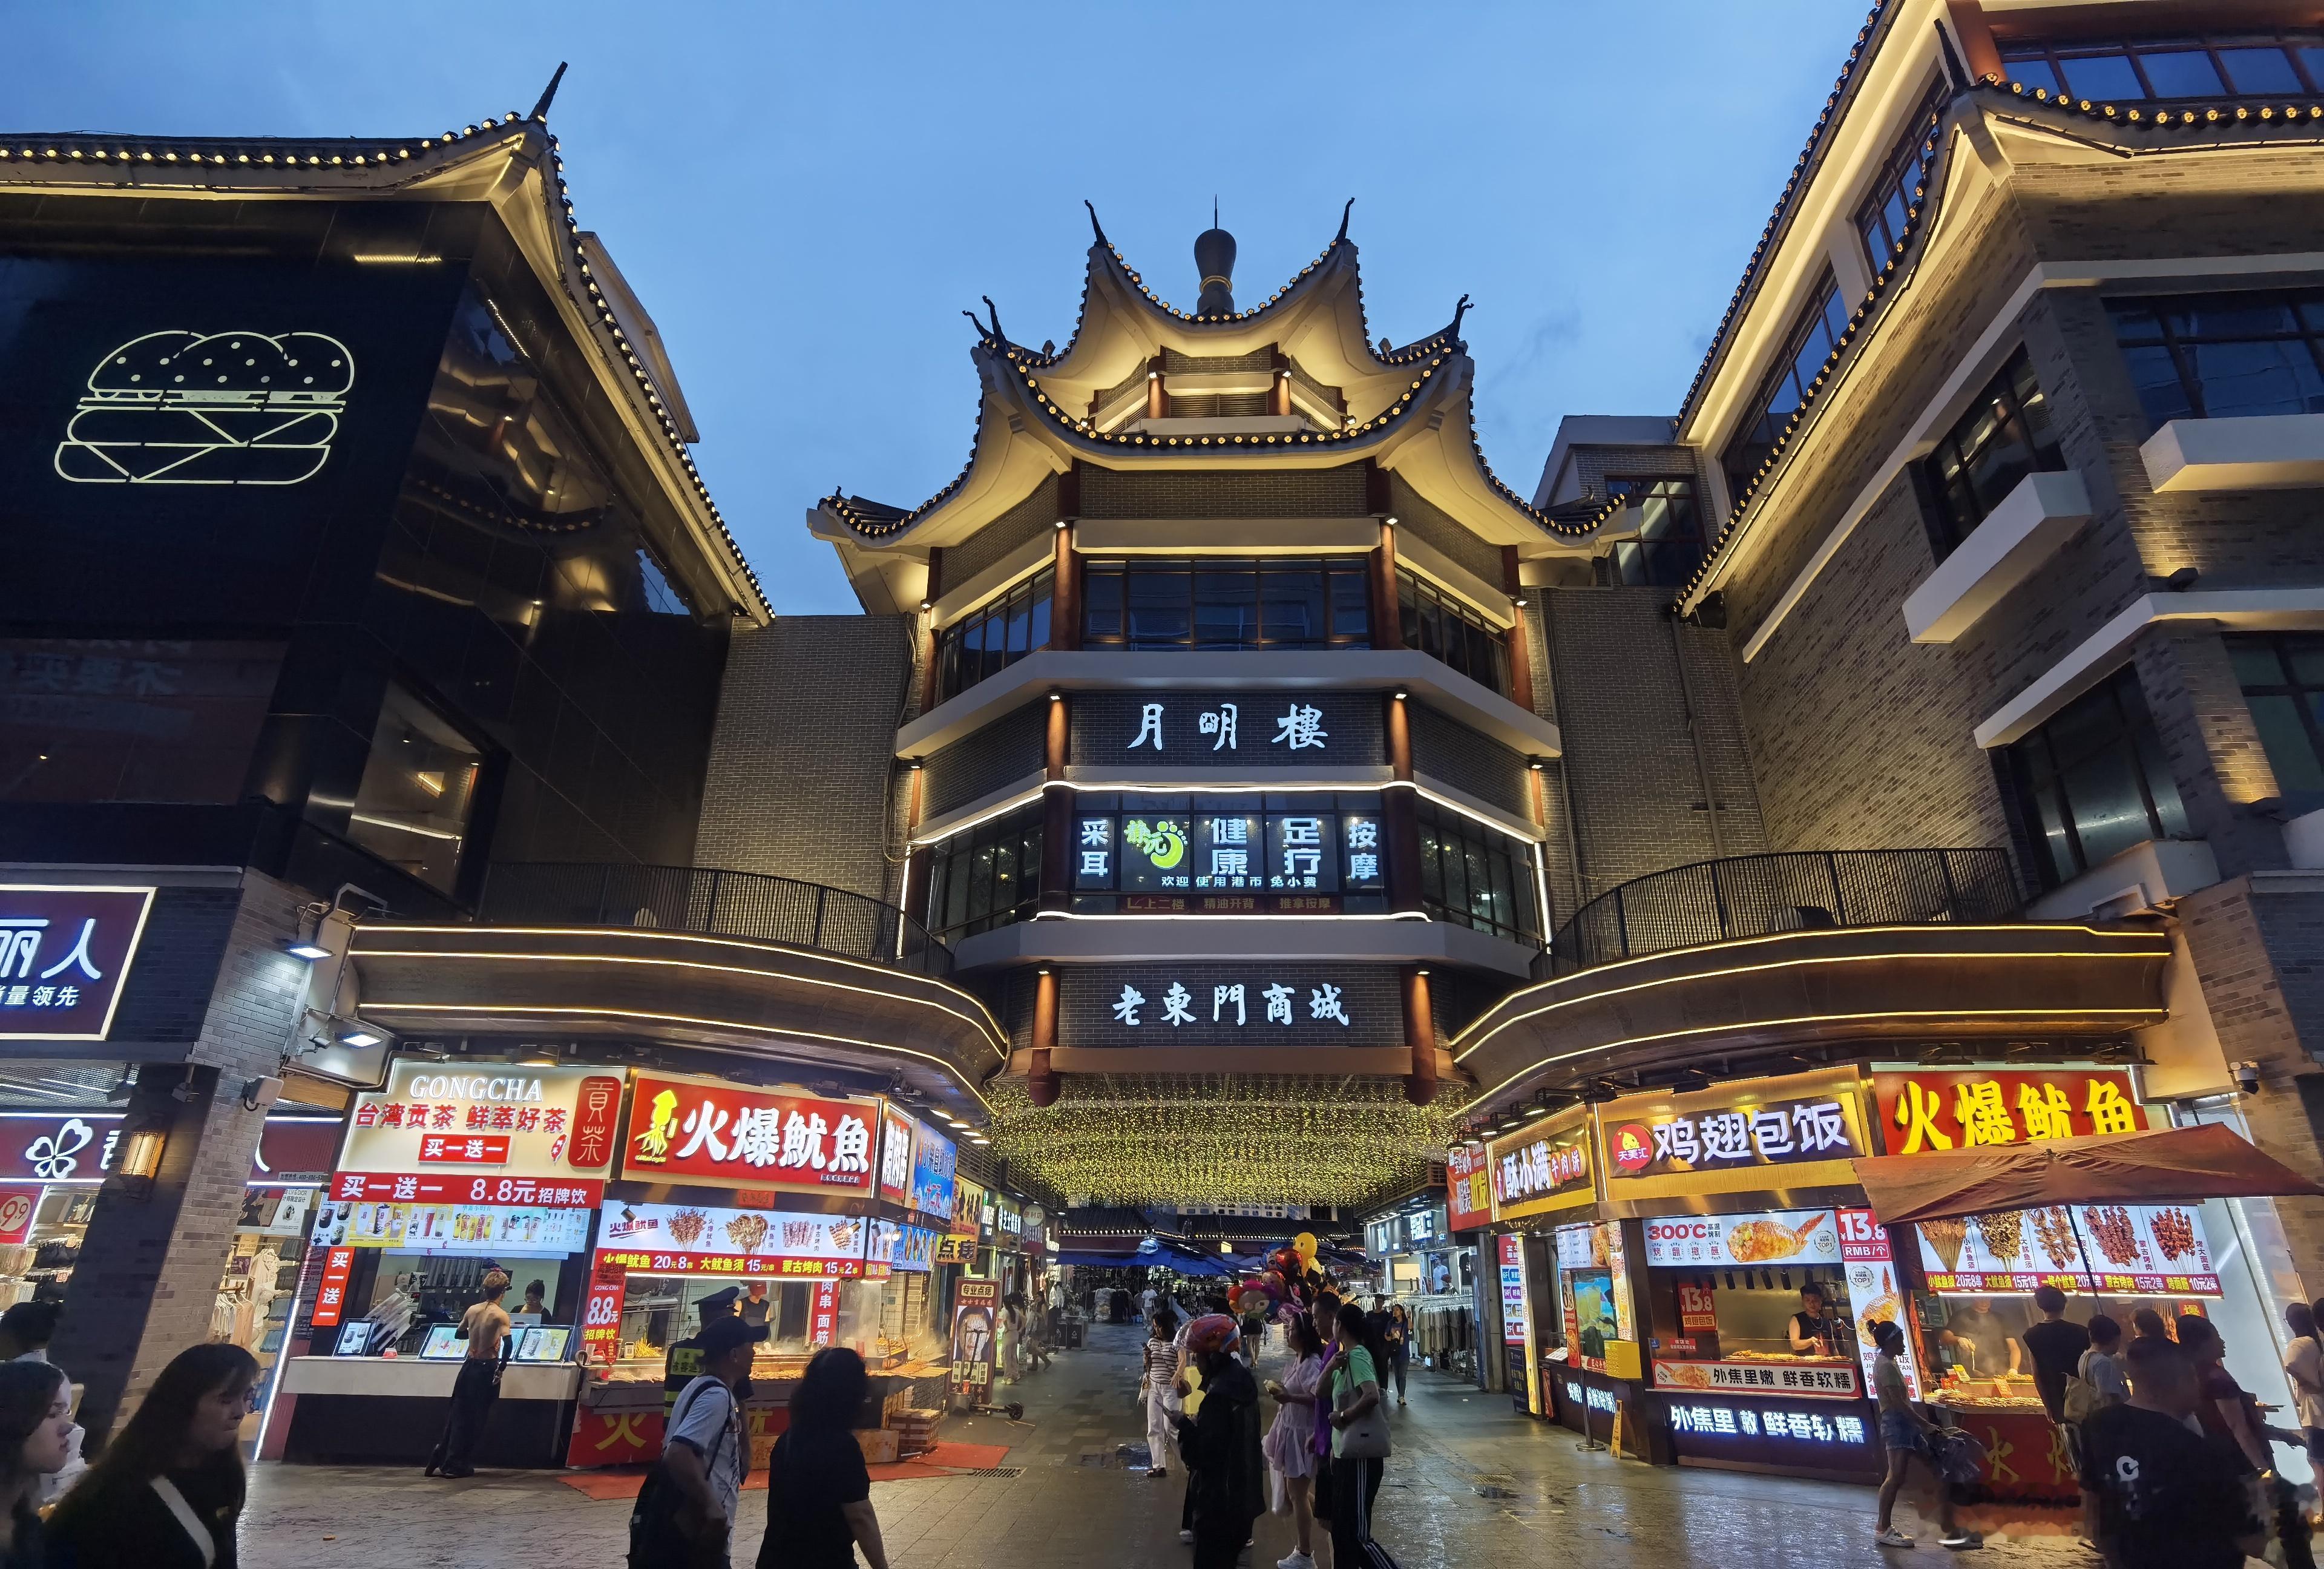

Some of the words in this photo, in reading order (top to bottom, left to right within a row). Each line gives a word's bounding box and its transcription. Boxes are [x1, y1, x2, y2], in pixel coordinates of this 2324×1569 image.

[1080, 819, 1109, 877] 采耳
[1210, 818, 1247, 876] 健康
[1282, 818, 1321, 875] 足疗
[1348, 822, 1378, 880] 按摩
[1113, 983, 1350, 1026] 老東門商城
[410, 1076, 542, 1101] GONGCHA
[355, 1102, 456, 1130] 台湾贡茶
[465, 1104, 567, 1134] 鲜萃好茶
[1895, 1079, 2138, 1155] 火爆鱿鱼
[1652, 1102, 1850, 1164] 鸡翅包饭
[425, 1139, 504, 1159] 买一送一
[1551, 1148, 1580, 1179] 牛肉饼
[341, 1176, 443, 1200] 买一送一
[470, 1177, 536, 1203] 8.8元
[537, 1186, 587, 1205] 招牌饮
[609, 1219, 658, 1233] 火爆鱿鱼
[700, 1257, 745, 1272] 大鱿鱼须
[782, 1260, 822, 1274] 蒙古烤肉
[318, 1251, 349, 1318] 买一送一
[585, 1329, 616, 1341] 招牌饮
[1684, 1316, 1714, 1326] 鸡翅包饭
[1713, 1367, 1775, 1386] 外焦里嫩
[1782, 1370, 1851, 1390] 鲜香软糯
